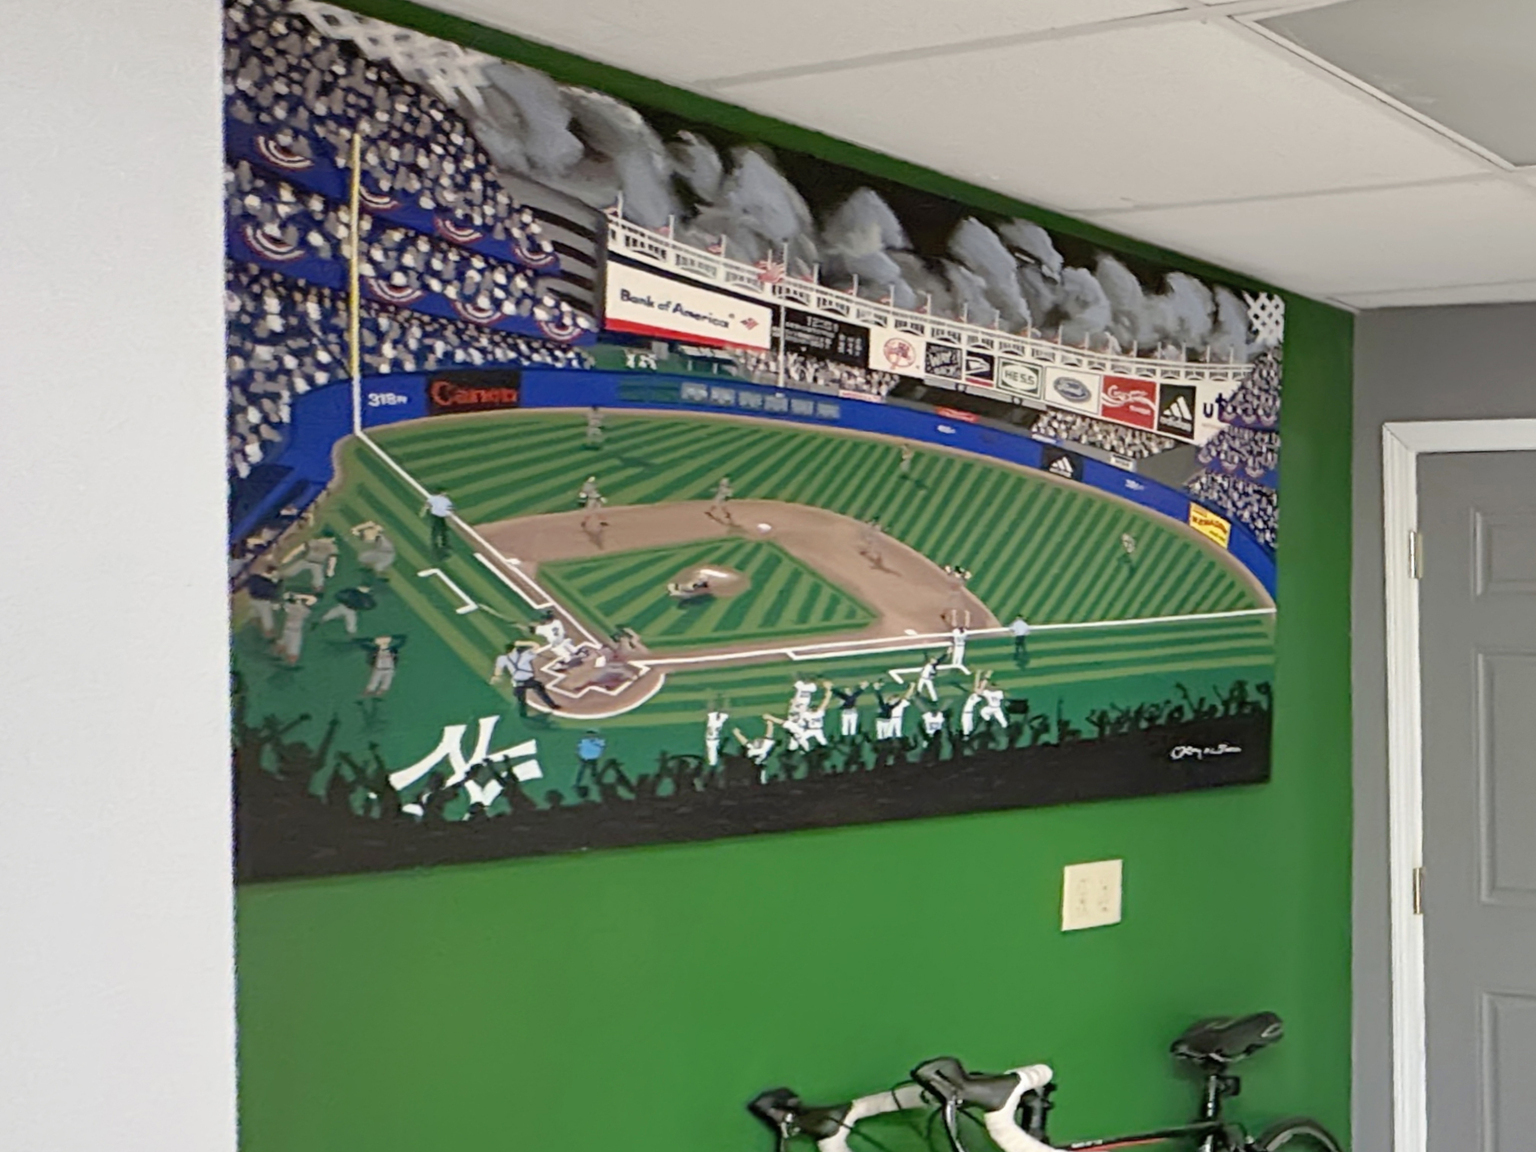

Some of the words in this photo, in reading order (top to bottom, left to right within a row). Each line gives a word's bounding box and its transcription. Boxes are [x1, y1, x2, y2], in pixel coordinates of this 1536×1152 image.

[620, 288, 655, 308] Bank
[657, 301, 672, 312] of
[672, 302, 730, 329] America
[1004, 370, 1036, 386] HESS
